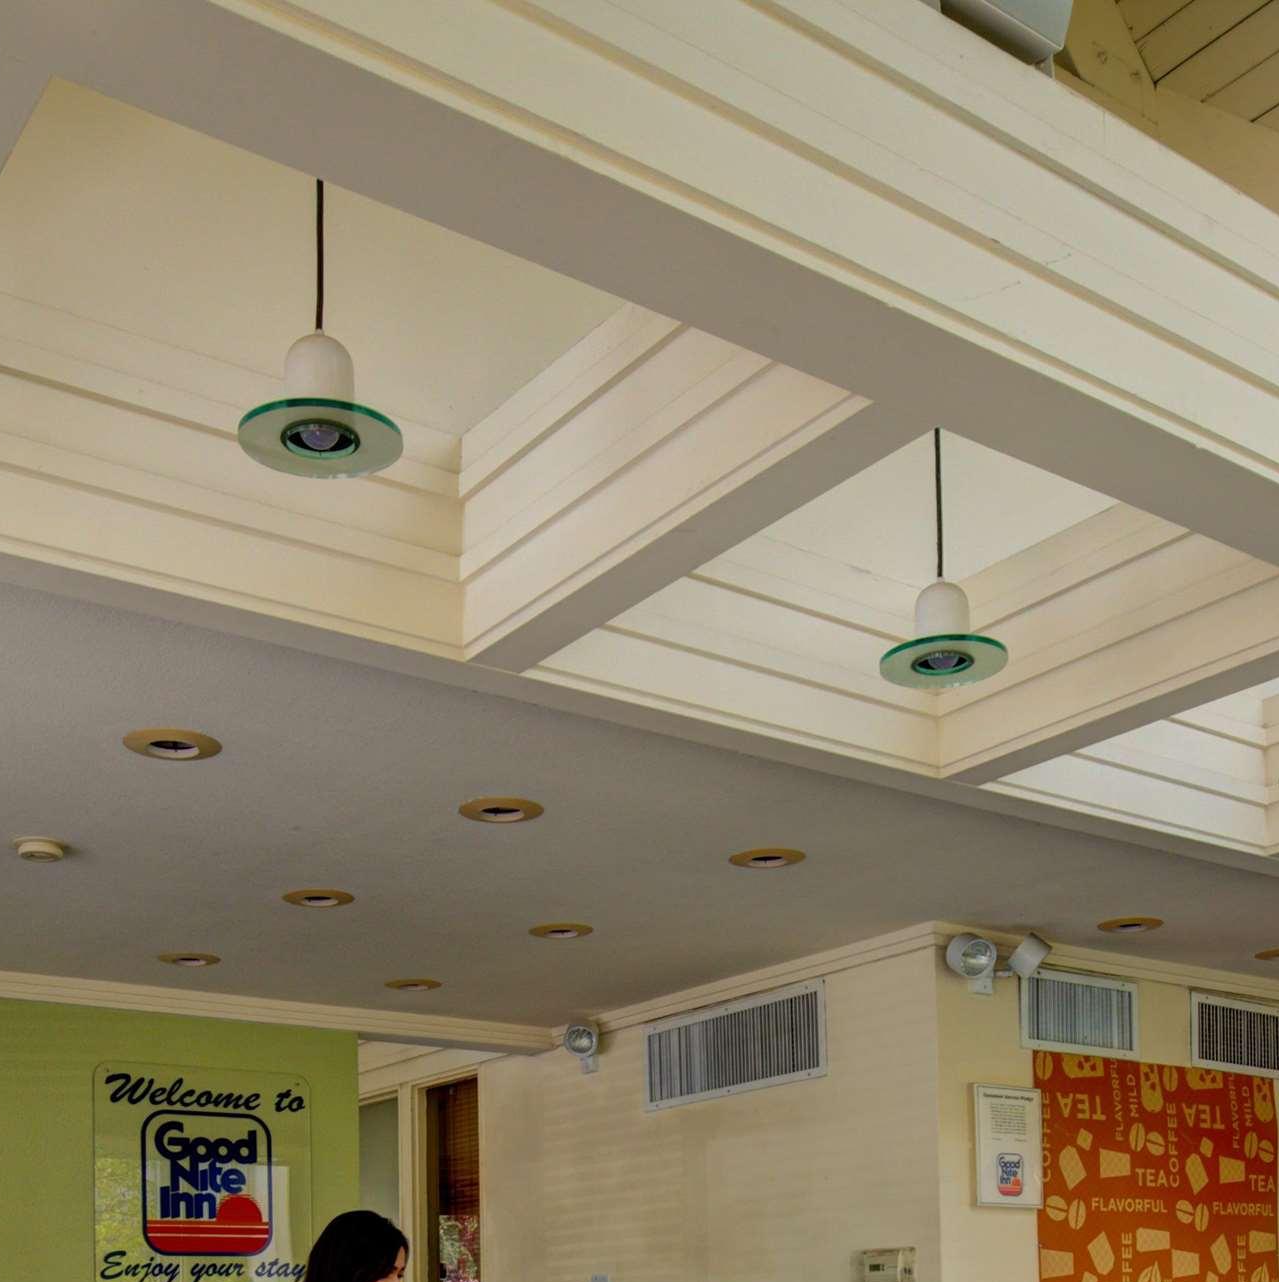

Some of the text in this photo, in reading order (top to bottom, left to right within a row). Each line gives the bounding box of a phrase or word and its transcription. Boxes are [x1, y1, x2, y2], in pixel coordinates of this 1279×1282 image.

[104, 1072, 306, 1113] Welcome to
[1056, 1091, 1106, 1121] TEA
[1126, 1074, 1139, 1118] MILD
[1242, 1086, 1253, 1127] MILD
[1182, 1103, 1225, 1130] TEA
[154, 1120, 257, 1165] Good
[1166, 1103, 1179, 1187] COFFEE
[170, 1158, 246, 1194] Nite
[1135, 1168, 1168, 1188] TEA
[1249, 1174, 1275, 1193] TEA
[159, 1186, 217, 1219] Inn
[1091, 1197, 1168, 1213] FLAVORFUL
[1212, 1201, 1274, 1217] FLAVORFUL
